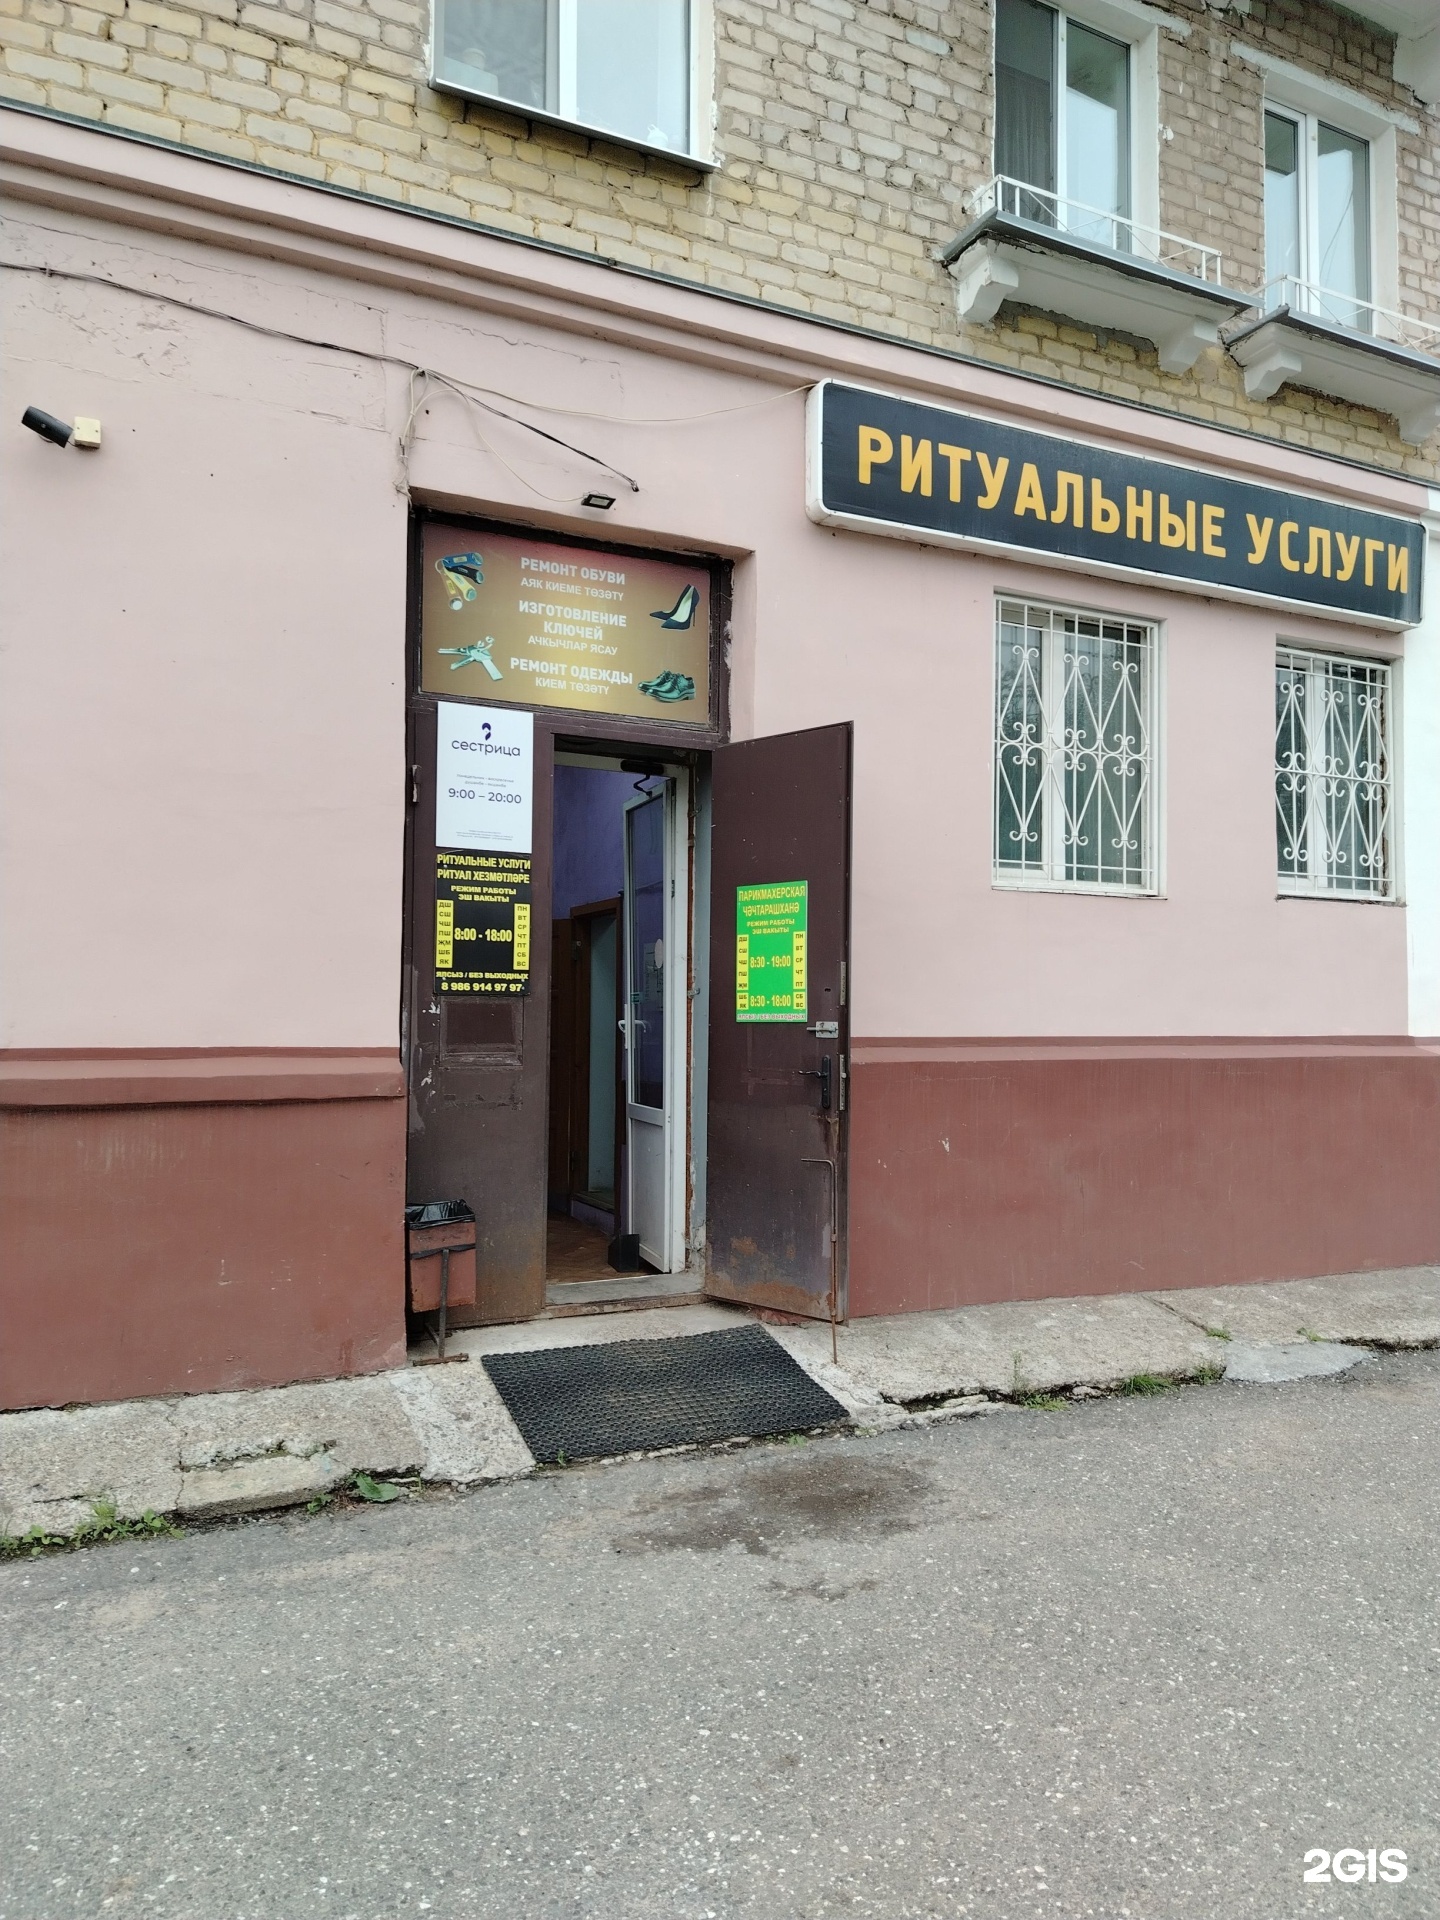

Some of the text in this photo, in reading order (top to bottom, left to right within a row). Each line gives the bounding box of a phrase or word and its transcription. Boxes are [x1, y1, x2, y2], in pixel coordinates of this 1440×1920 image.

[858, 424, 1409, 594] РИТУАЛЬНЫЕ УСЛУГИ
[520, 557, 626, 585] РЕМОНТ ОБУВИ
[520, 577, 624, 601] АЯК КИЕМЕ ТӨЗӘТҮ
[519, 600, 627, 627] ИЗГОТОВЛЕНИЕ
[544, 620, 603, 640] КЛЮЧЕЙ
[528, 635, 617, 656] АЧКЫЧЛАР ЯСАУ
[510, 657, 633, 685] РЕМОНТ ОДЕЖДЫ
[535, 677, 609, 695] КИЕМ ТӨЗӘТҮ
[451, 740, 521, 756] сестрица
[448, 788, 475, 800] 9:00
[488, 792, 521, 803] 20:00
[437, 854, 530, 870] РИТУАЛЬНЫЕ УСЛУГИ
[437, 869, 530, 884] РИТУАЛ ХЕЗМӘТЛӘРЕ
[451, 885, 516, 895] РЕЖИМ РАБОТЫ
[738, 885, 806, 902] ПАРИКМАХЕРСКАЯ
[742, 902, 800, 917] ЧӘЧТАРАШХАНӘ
[769, 918, 795, 926] РАБОТЫ
[454, 928, 476, 940] 8:00
[485, 929, 512, 942] 18:00
[750, 956, 765, 968] 8:30
[771, 955, 791, 968] 19:00
[484, 972, 528, 980] ВЫХОДНЫХ
[441, 982, 522, 992] 8 986 914 97 97
[750, 995, 765, 1007] 8:30
[771, 994, 791, 1007] 18:00
